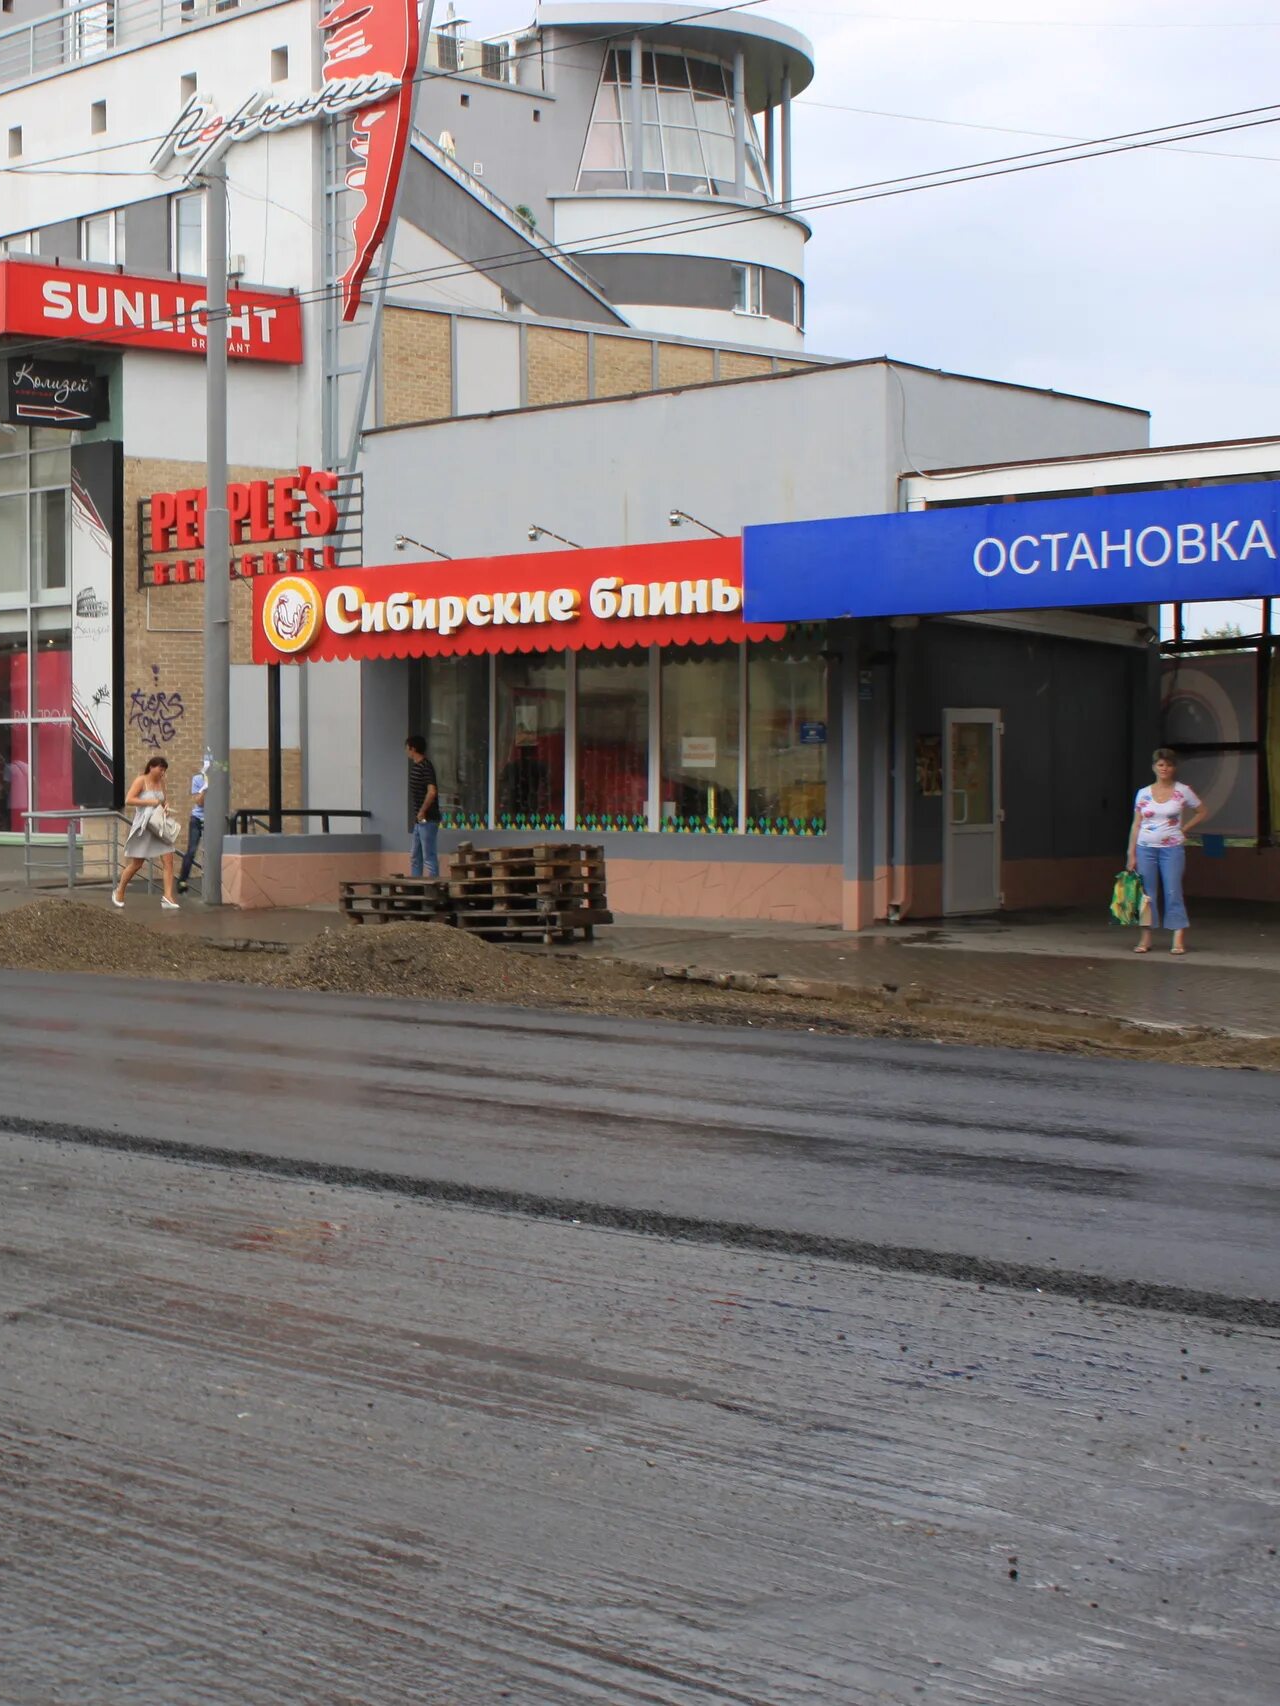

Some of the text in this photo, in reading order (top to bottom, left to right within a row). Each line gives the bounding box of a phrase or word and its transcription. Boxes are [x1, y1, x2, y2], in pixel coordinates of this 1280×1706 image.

[191, 338, 251, 354] BRANT
[13, 363, 89, 403] Колизей
[973, 519, 1277, 577] ОСТАНОВКА
[325, 585, 580, 635] Сибирские
